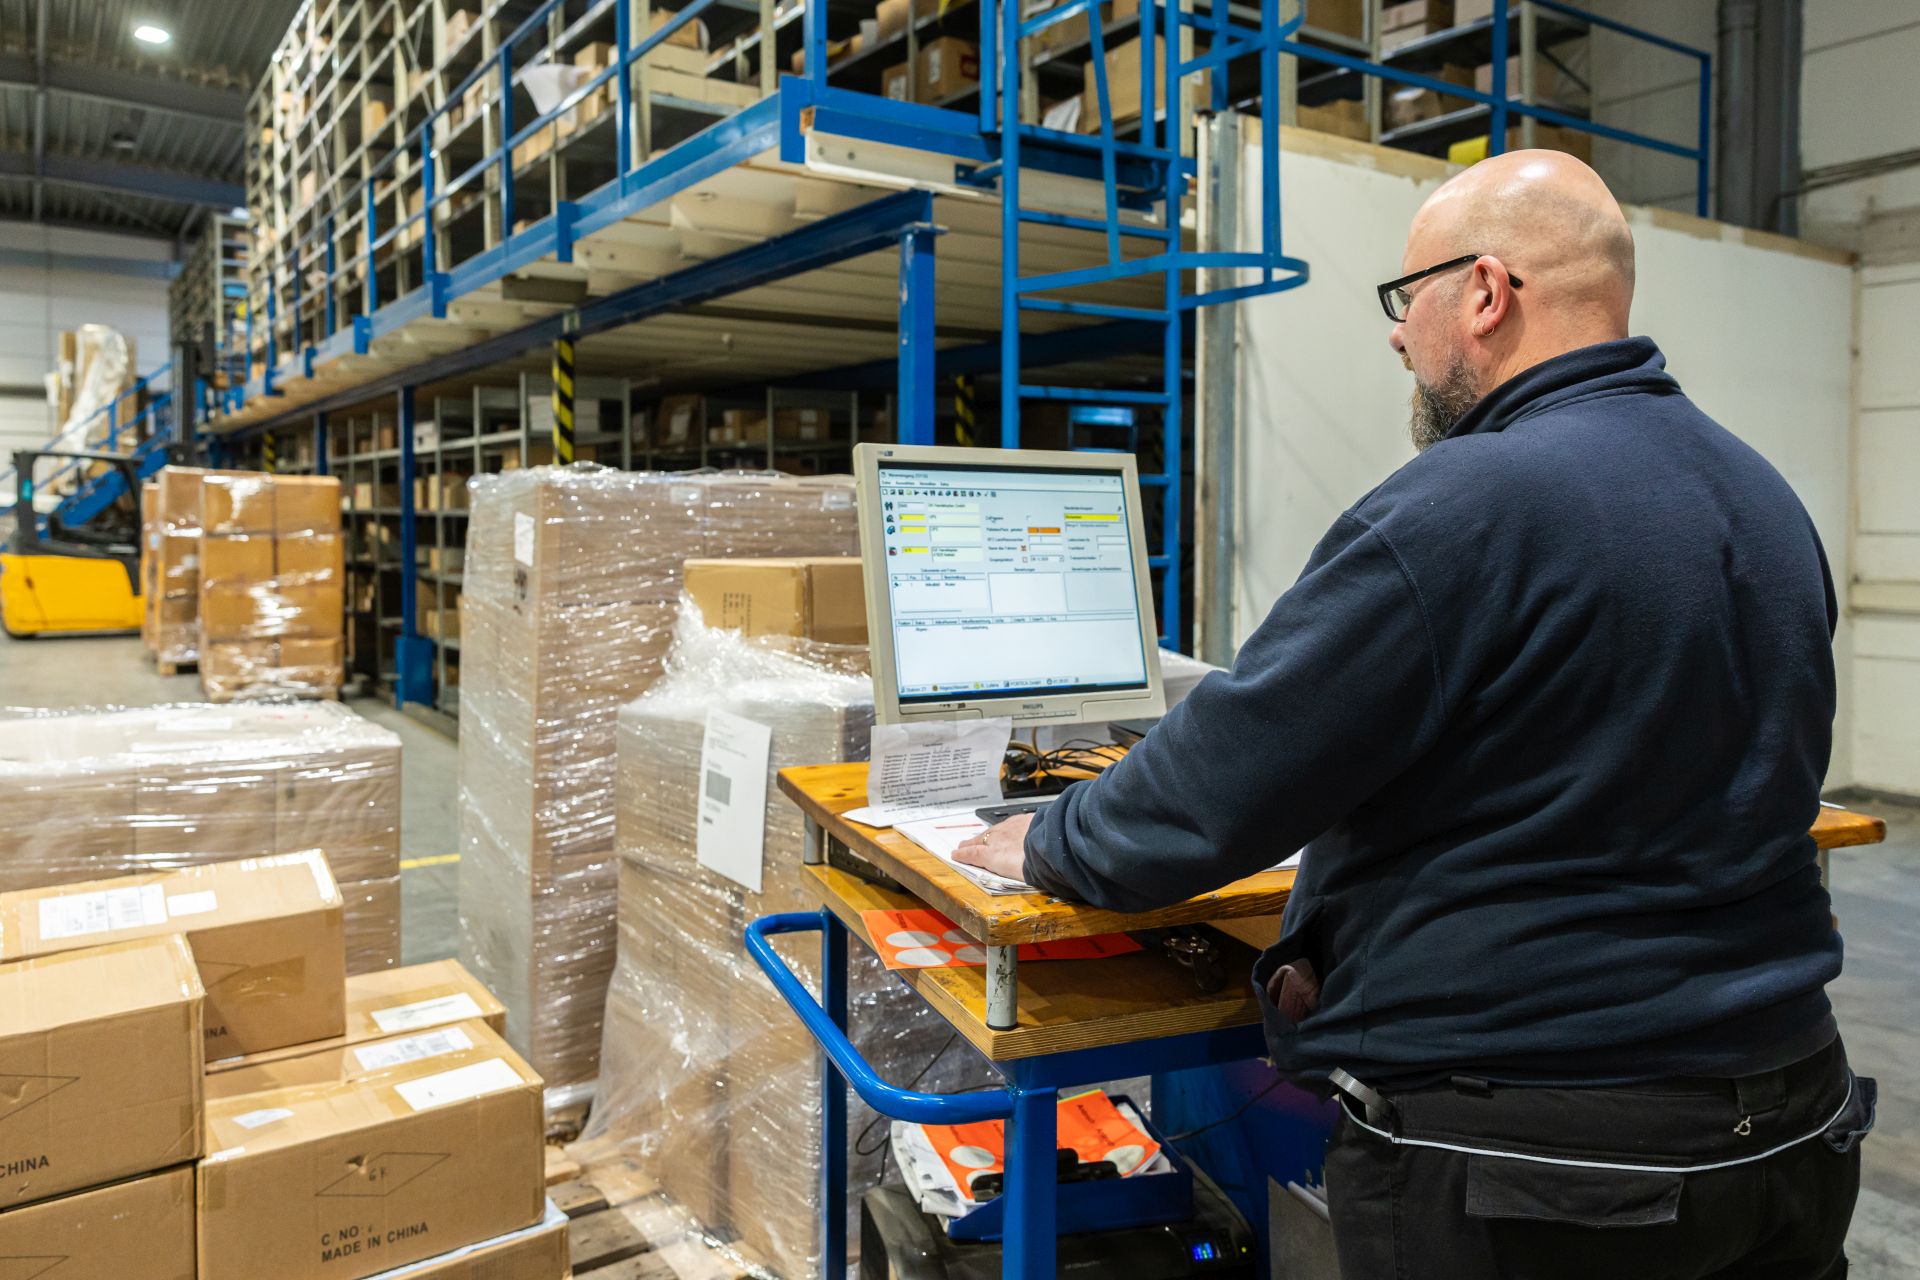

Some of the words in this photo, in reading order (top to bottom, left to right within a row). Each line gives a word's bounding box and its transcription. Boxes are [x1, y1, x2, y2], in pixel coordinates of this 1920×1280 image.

[321, 1241, 361, 1263] MADE
[367, 1235, 381, 1249] IN
[387, 1221, 429, 1244] CHINA
